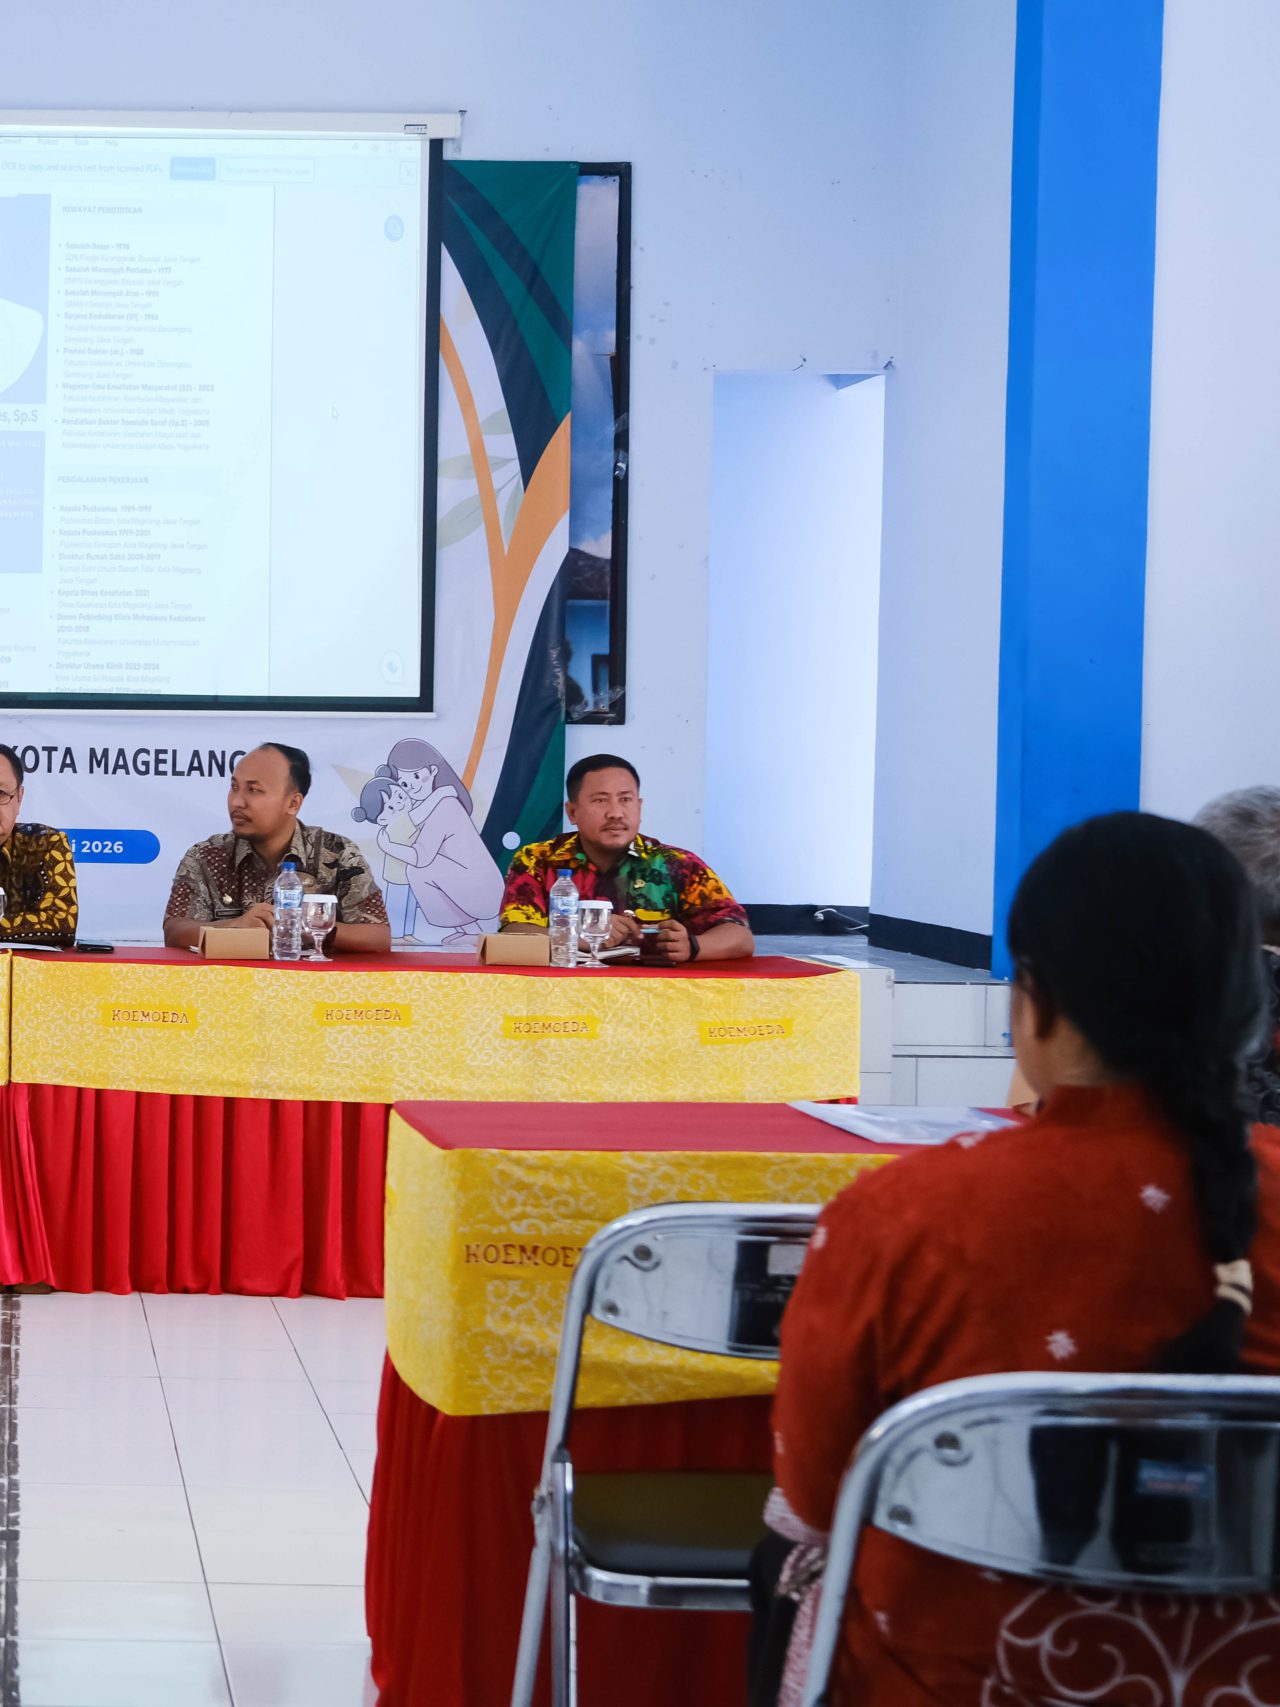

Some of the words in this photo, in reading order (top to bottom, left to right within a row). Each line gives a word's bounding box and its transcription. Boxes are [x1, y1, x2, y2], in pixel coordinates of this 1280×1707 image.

[13, 409, 38, 425] Sp.S
[81, 840, 124, 854] 2026
[112, 1009, 189, 1025] KOEMOEDA
[325, 1008, 402, 1023] KOEMOEDA
[513, 1020, 590, 1035] KOEMOEDA
[708, 1024, 786, 1040] KOEMOEDA
[464, 1243, 583, 1268] KOEMOE
